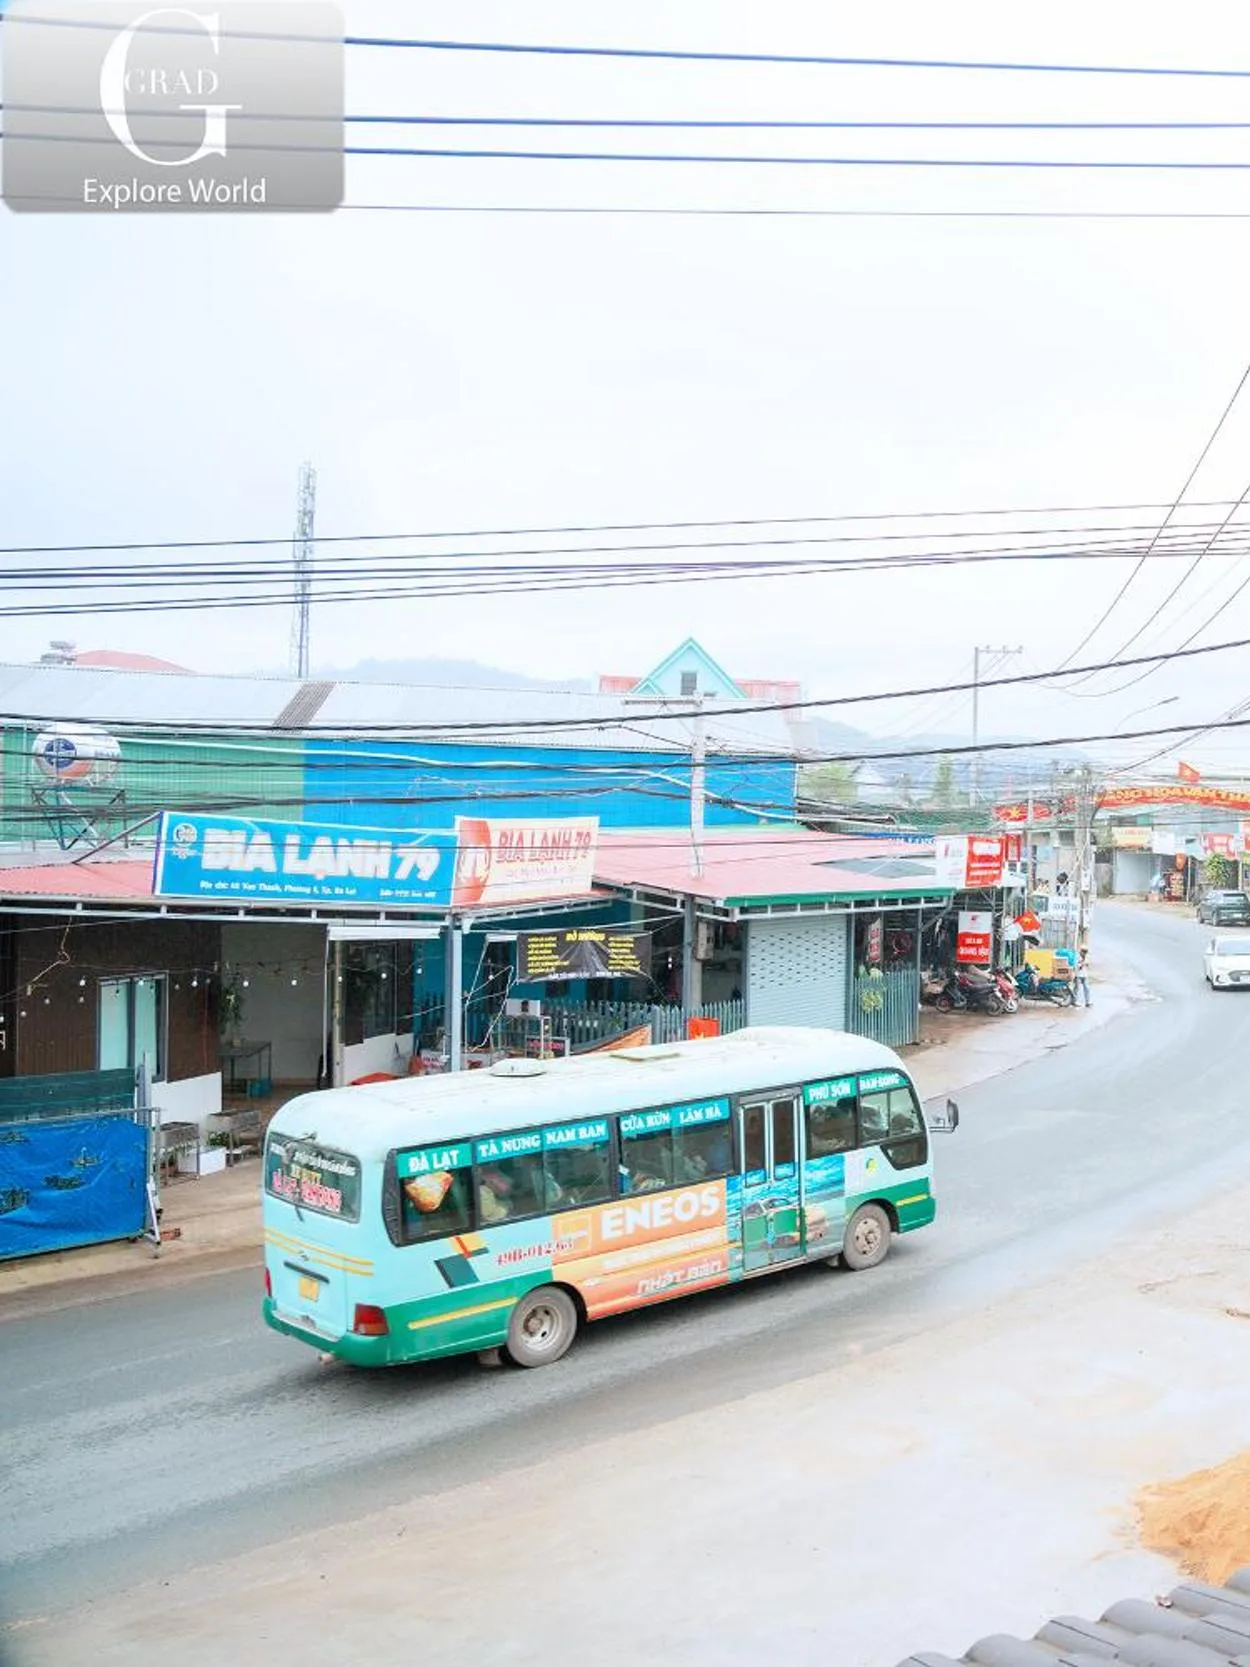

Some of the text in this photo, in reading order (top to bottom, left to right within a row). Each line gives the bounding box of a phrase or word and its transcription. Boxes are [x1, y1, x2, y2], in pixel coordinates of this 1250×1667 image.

[201, 828, 277, 873] BIA
[394, 846, 440, 881] 79
[496, 830, 525, 861] BIA
[501, 1134, 541, 1152] NUNG
[546, 1123, 606, 1145] NAM BAN
[408, 1149, 459, 1173] ĐÀ LẠT
[601, 1185, 721, 1241] ENEOS
